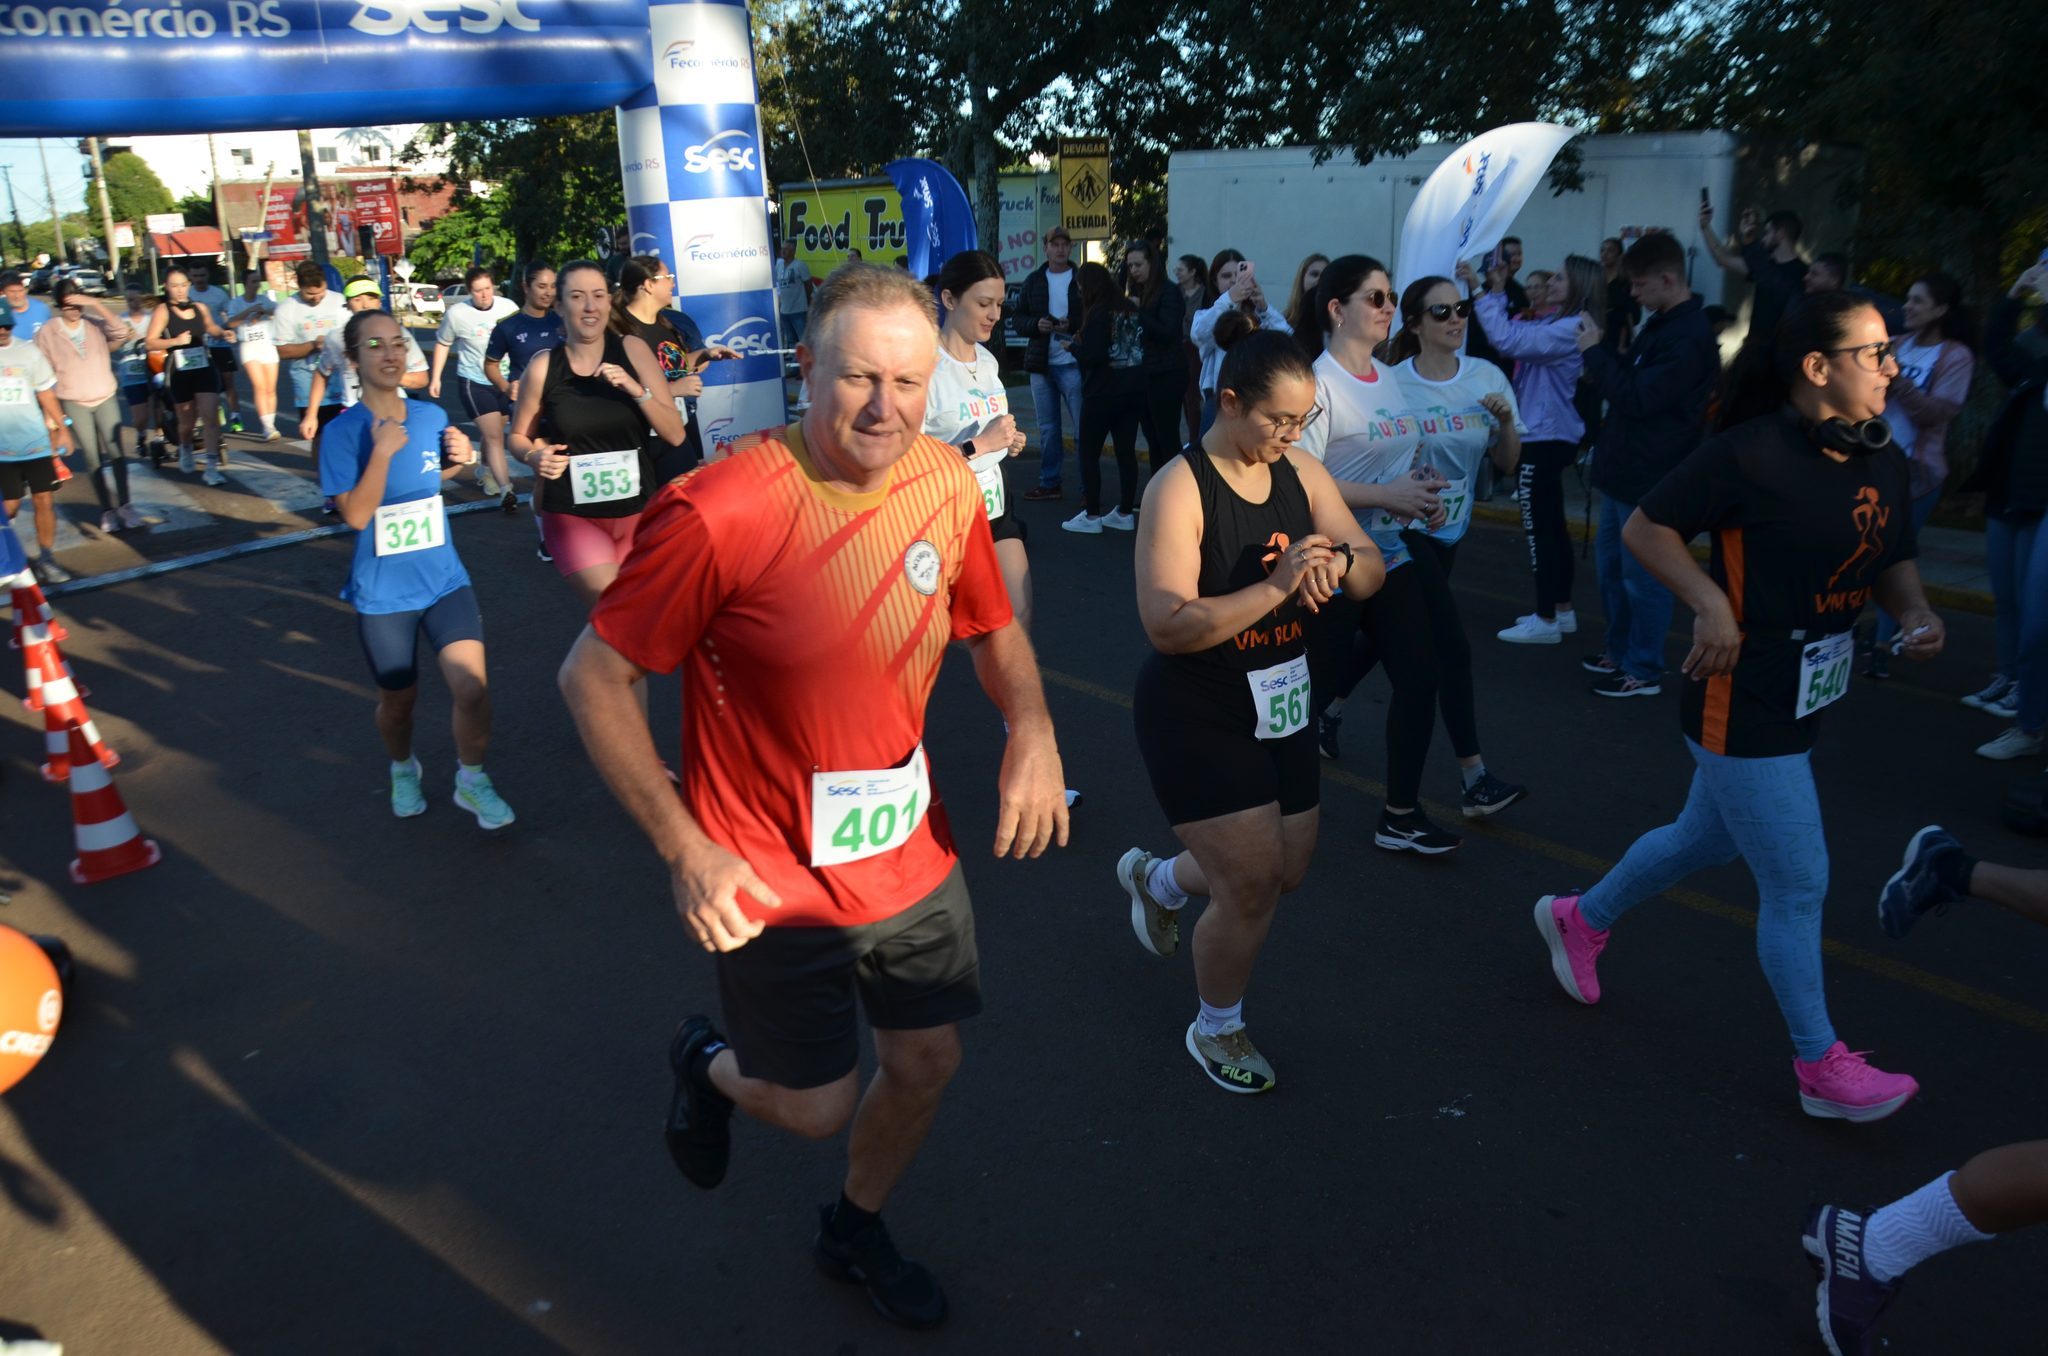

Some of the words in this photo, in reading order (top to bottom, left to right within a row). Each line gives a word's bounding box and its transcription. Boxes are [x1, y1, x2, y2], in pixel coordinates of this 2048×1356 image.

[228, 0, 291, 38] RS
[645, 158, 660, 170] RS
[1063, 143, 1106, 155] DEVAGAR
[789, 200, 851, 252] Food
[1066, 214, 1108, 229] ELEVADA
[582, 469, 631, 498] 353
[1519, 464, 1536, 530] GROWTH
[385, 517, 432, 549] 321
[1806, 657, 1849, 711] 540
[1269, 680, 1310, 734] 567
[832, 789, 918, 853] 401
[1220, 1065, 1253, 1085] FILA
